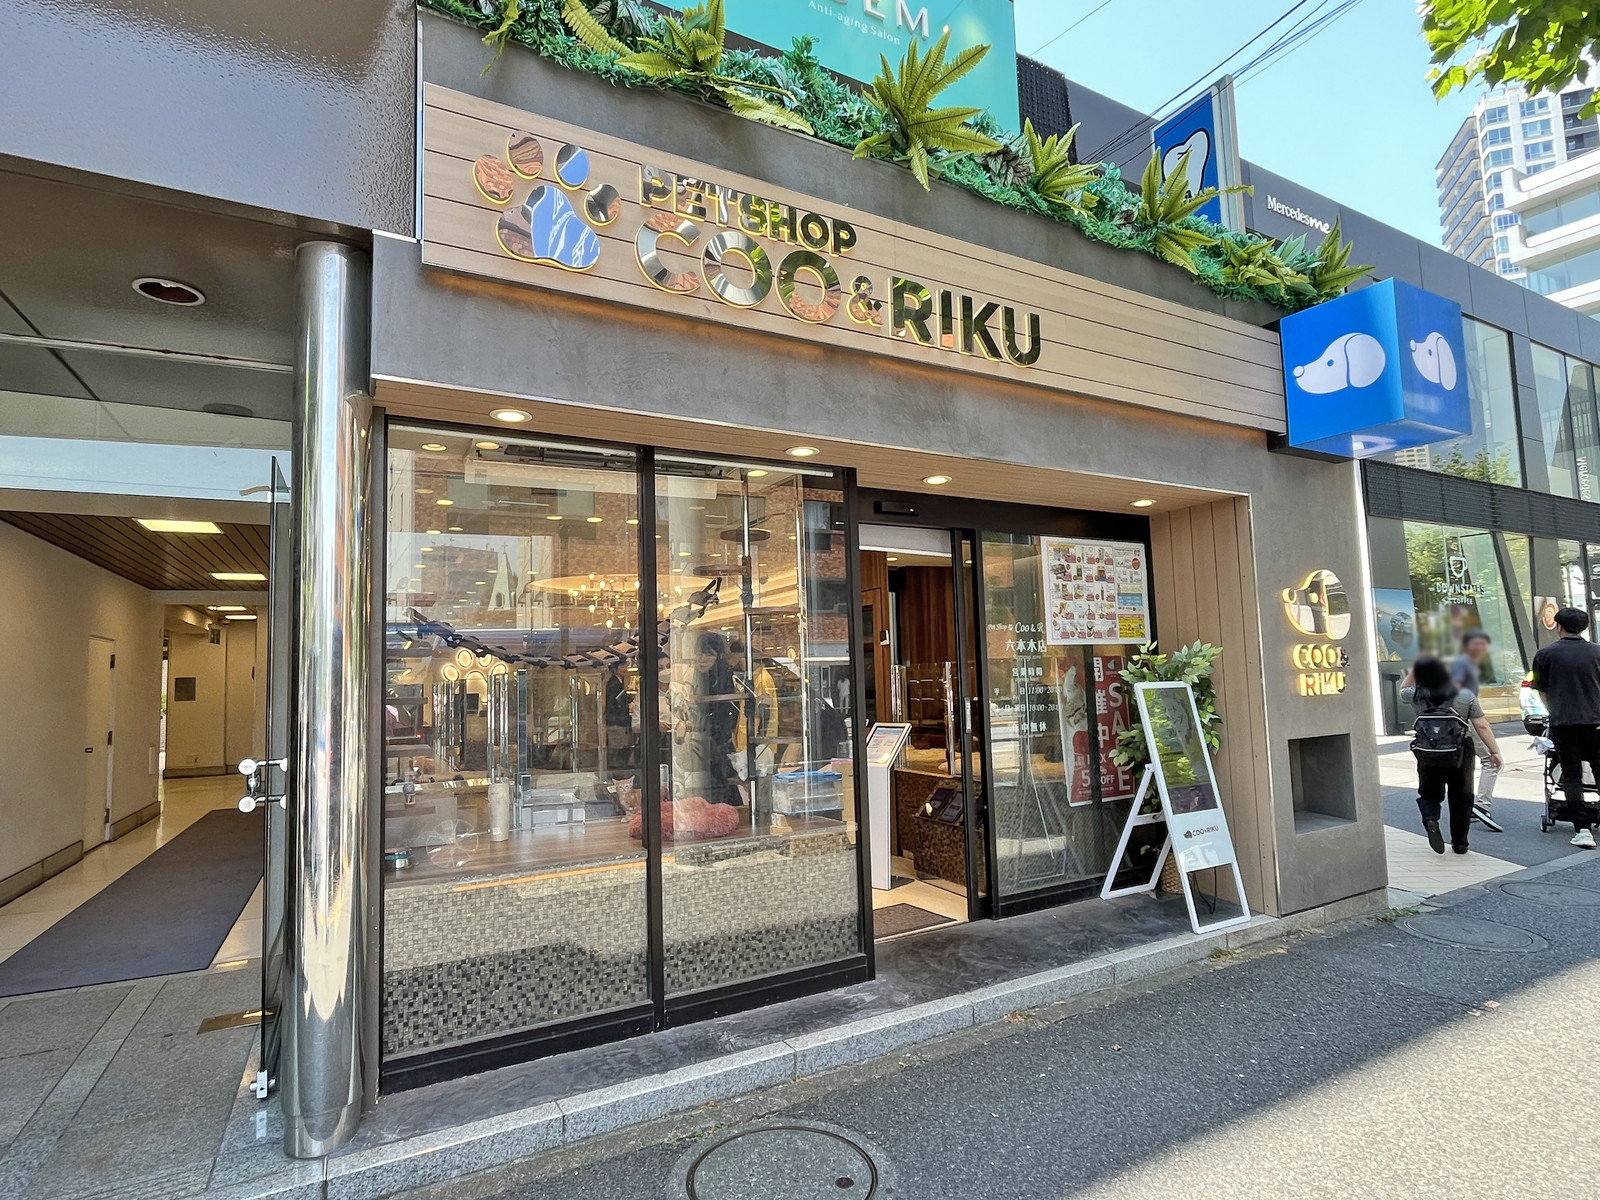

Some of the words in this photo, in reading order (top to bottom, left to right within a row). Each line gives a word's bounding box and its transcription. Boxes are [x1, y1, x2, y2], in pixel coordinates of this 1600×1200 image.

[808, 0, 868, 34] Anti-aging
[870, 26, 900, 45] Salon
[1005, 638, 1047, 653] 六本木店
[1299, 671, 1347, 696] RIKU
[1100, 774, 1116, 785] OFF
